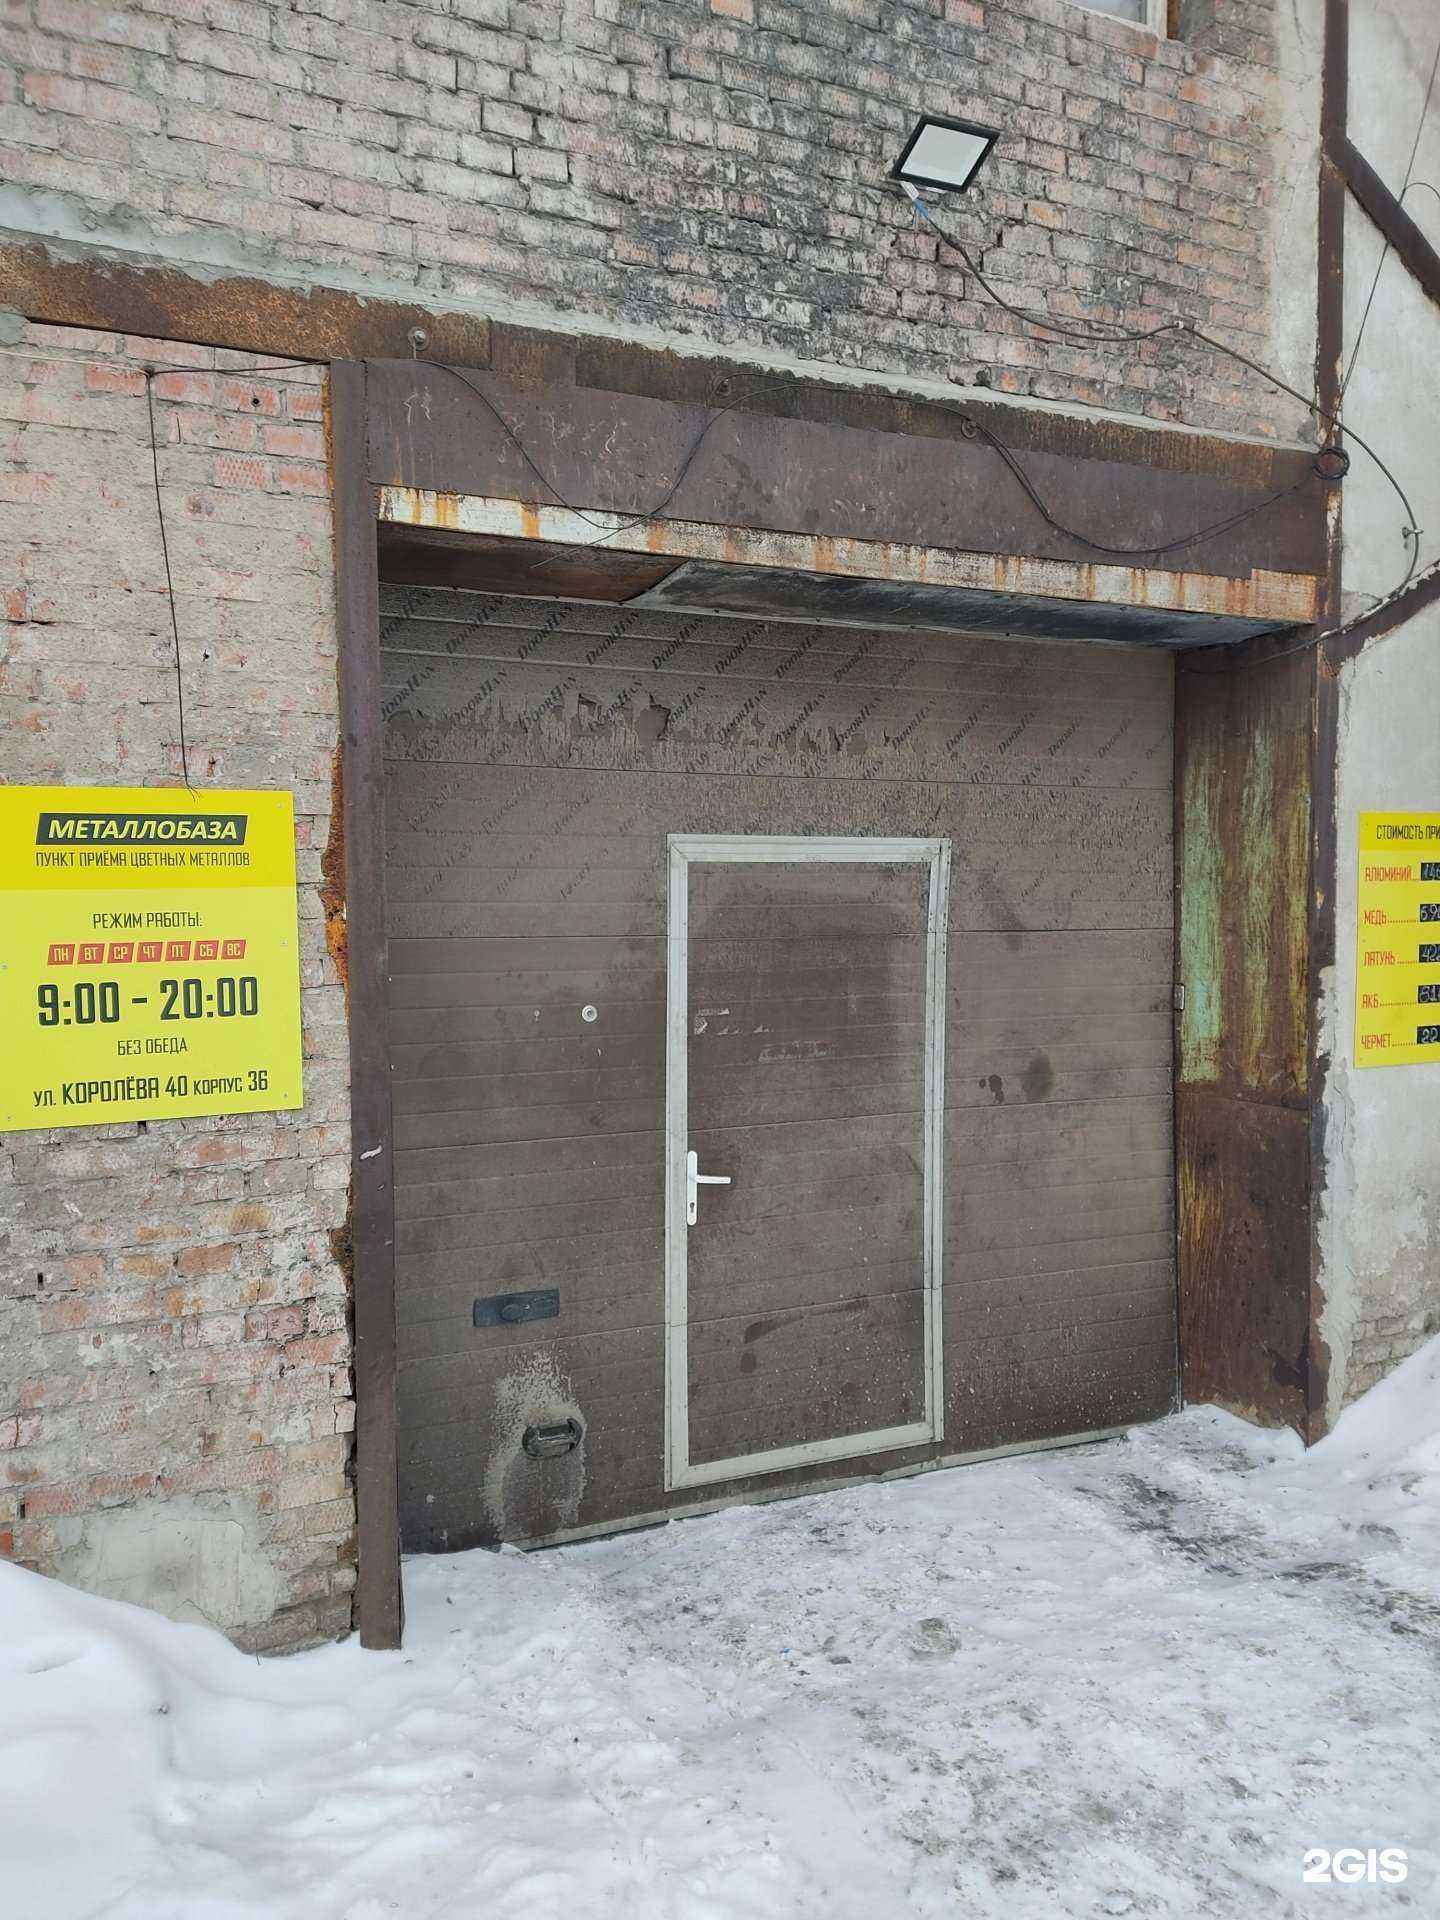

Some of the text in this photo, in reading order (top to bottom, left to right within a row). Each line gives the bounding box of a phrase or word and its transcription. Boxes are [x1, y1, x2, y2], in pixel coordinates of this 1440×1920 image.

[48, 819, 237, 840] МЕТАЛЛОБАЗА
[1376, 825, 1423, 840] СТОИМОСТЬ
[36, 850, 250, 868] ПУНКТ ПРИЁМА ЦВЕТНЫХ МЕТАЛЛОВ
[1365, 865, 1411, 881] АЛЮМИНИЙ
[93, 911, 203, 929] РЕЖИМ РАБОТЫ:
[1364, 910, 1387, 925] МЕДЬ
[53, 943, 240, 961] ПН ВТ СР ЧТ ПТ СБ ВС
[1364, 951, 1395, 966] ЛАТУНЬ
[37, 983, 120, 1026] 9:00
[160, 976, 258, 1020] 20:00
[1362, 993, 1379, 1008] АКБ
[117, 1037, 188, 1056] БЕЗ ОБЕДА
[1361, 1033, 1391, 1049] ЧЕРМЕТ
[62, 1076, 159, 1105] КОРОЛЁВА
[164, 1075, 188, 1097] 40
[193, 1077, 243, 1096] КОРПУС
[247, 1070, 269, 1091] 36
